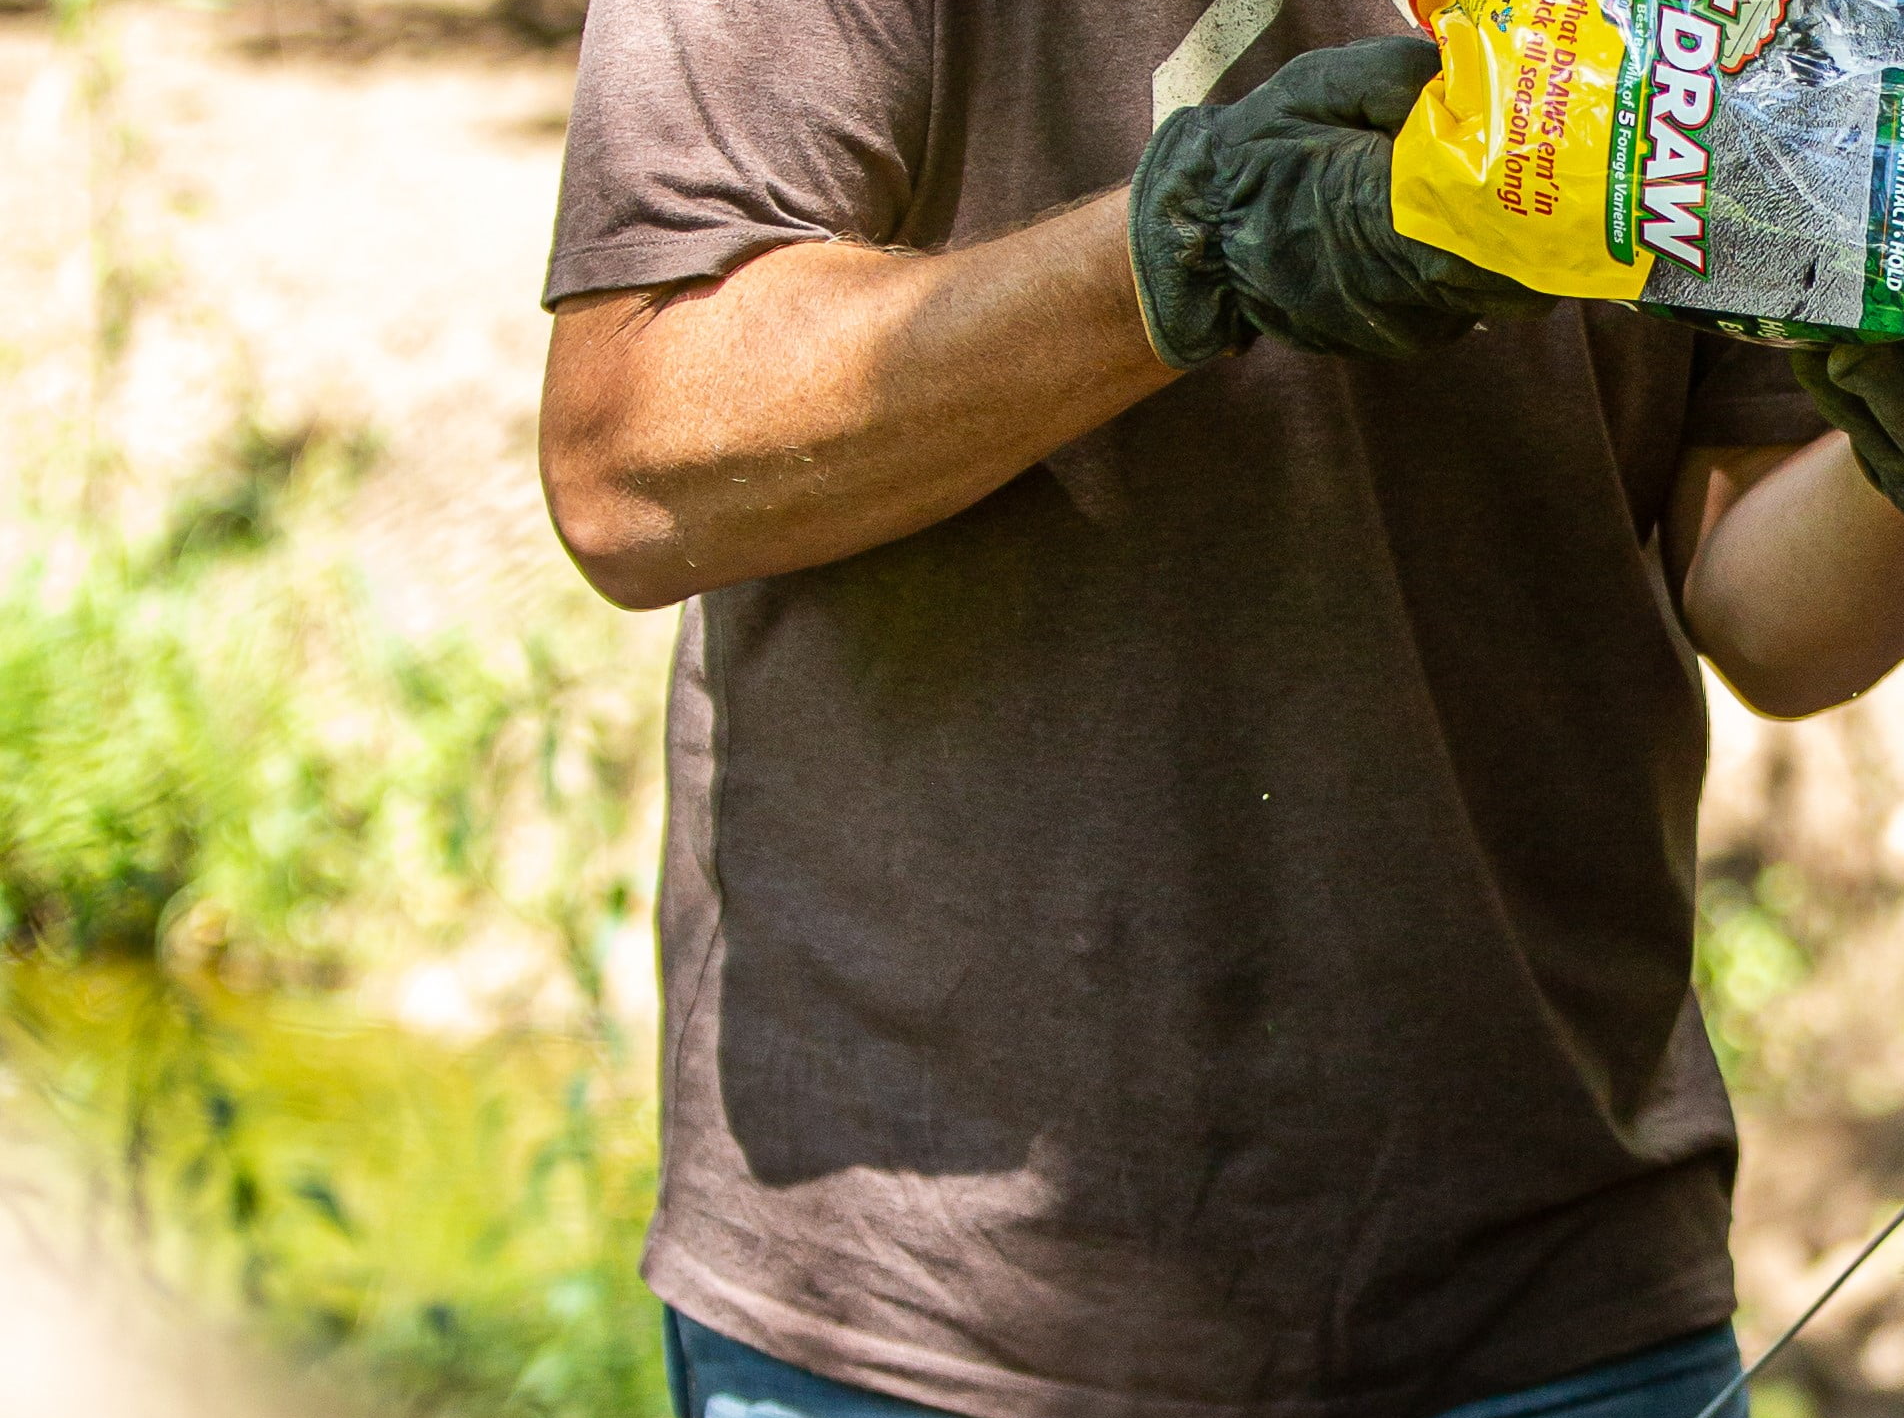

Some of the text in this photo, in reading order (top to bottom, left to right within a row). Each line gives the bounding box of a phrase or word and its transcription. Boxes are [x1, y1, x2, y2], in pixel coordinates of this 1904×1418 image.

[1508, 64, 1538, 146] season
[1540, 47, 1577, 140] DRAWS
[1618, 109, 1636, 128] 5
[1621, 90, 1635, 108] of
[1613, 127, 1632, 181] Forage
[1641, 5, 1723, 274] DRAW
[1496, 148, 1532, 217] long!
[1534, 189, 1559, 216] in
[1607, 182, 1628, 245] Varieties
